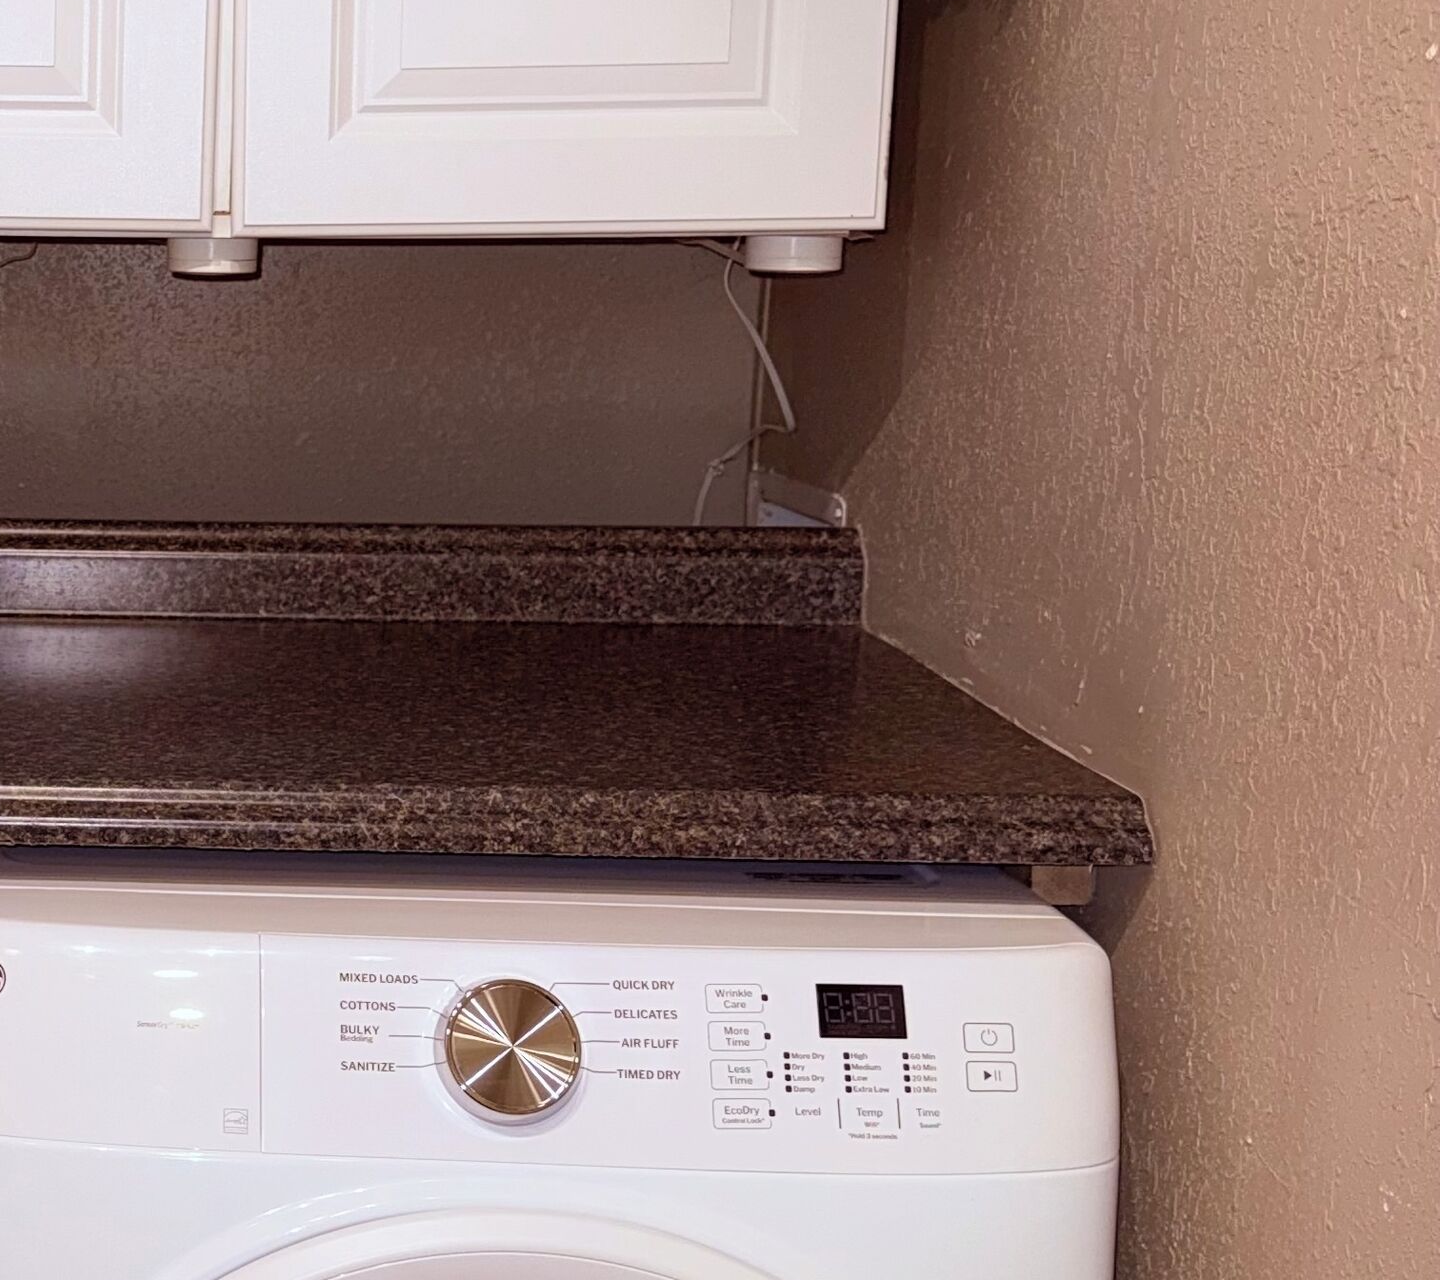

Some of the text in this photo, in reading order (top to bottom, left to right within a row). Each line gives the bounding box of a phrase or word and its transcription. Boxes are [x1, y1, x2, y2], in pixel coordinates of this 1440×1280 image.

[340, 972, 418, 984] MIXED LOADS
[613, 980, 675, 991] QUICK DRY
[715, 989, 753, 998] Wrinkle
[340, 1001, 396, 1011] COTTONS
[723, 1000, 747, 1009] Care
[614, 1009, 678, 1020] DELICATES
[340, 1024, 380, 1035] BULKY
[723, 1026, 750, 1035] More
[621, 1039, 679, 1049] AIR FLUFF
[726, 1038, 750, 1047] Time
[812, 1052, 825, 1060] Dry
[850, 1053, 868, 1061] High
[341, 1061, 396, 1072] SANITIZE
[727, 1064, 751, 1074] Less
[851, 1063, 881, 1071] Medium
[617, 1069, 681, 1080] TIMED DRY
[812, 1075, 825, 1083] Dry
[728, 1076, 753, 1085] Time
[794, 1086, 816, 1094] Damp
[724, 1106, 760, 1116] EcoDry
[795, 1107, 821, 1116] Level
[857, 1107, 883, 1118] Temp
[916, 1108, 940, 1117] Time
